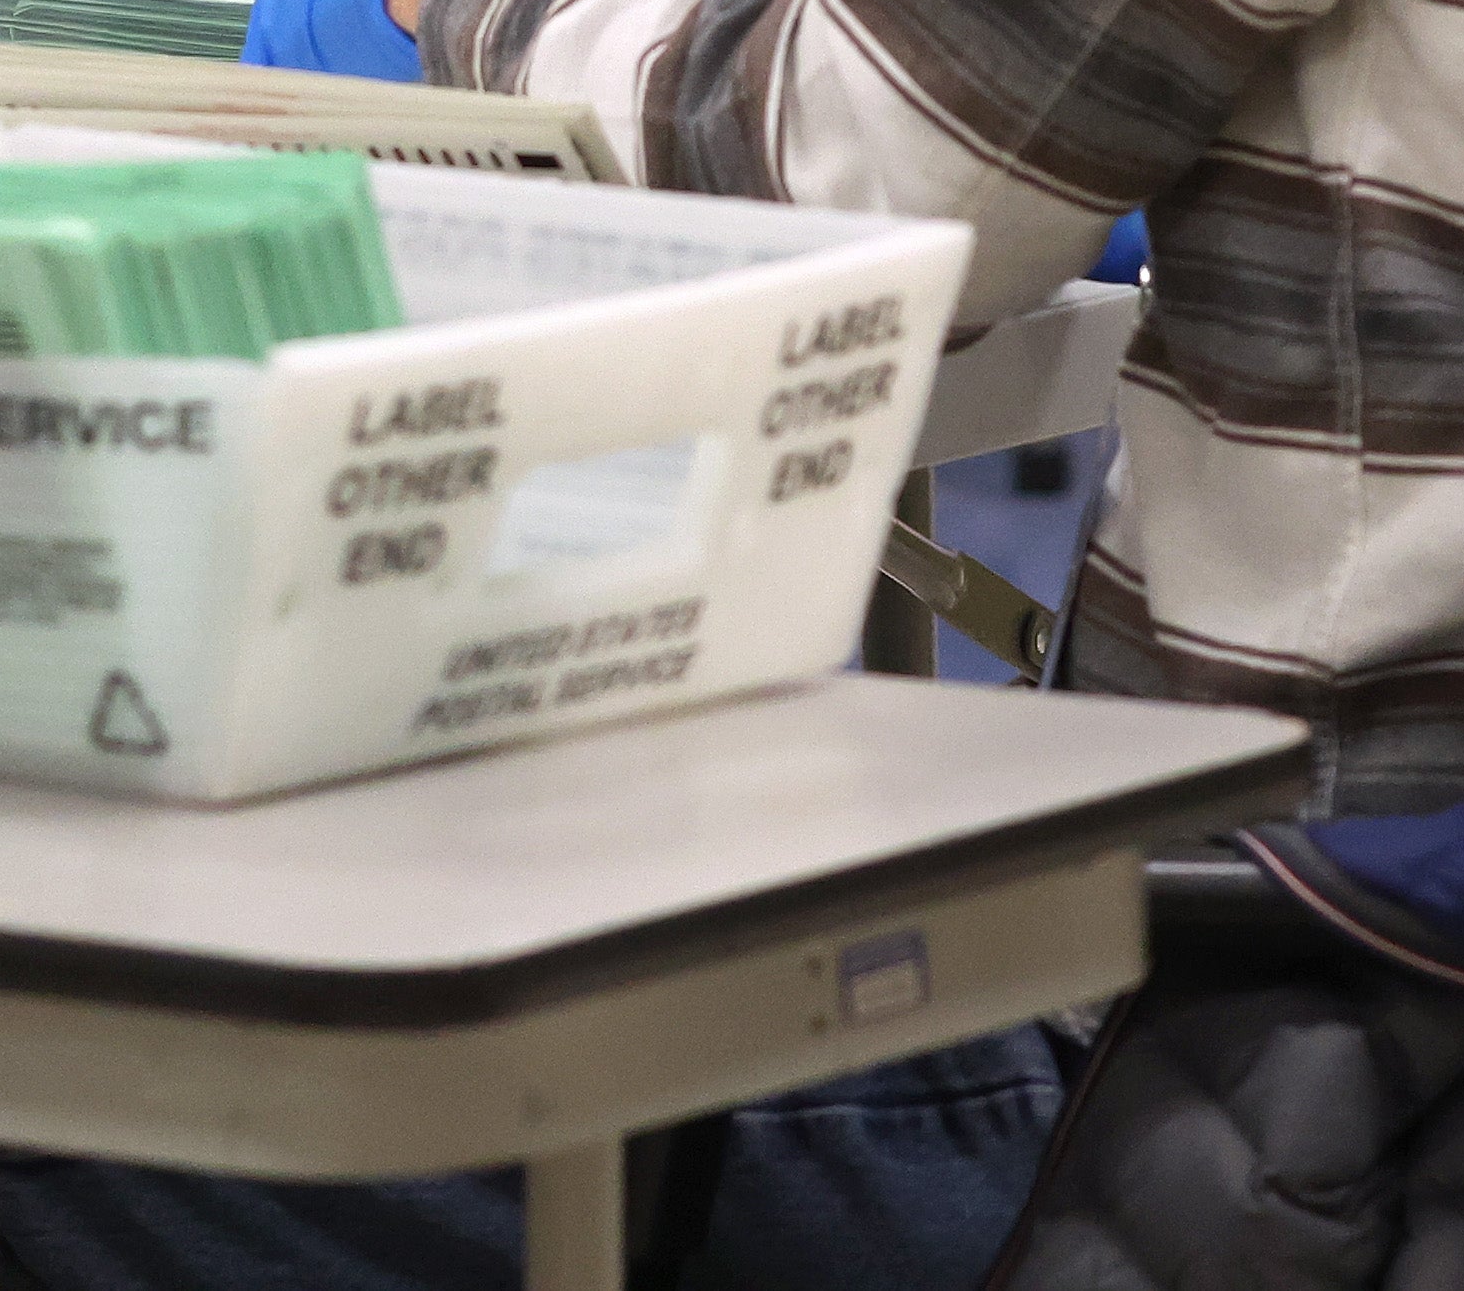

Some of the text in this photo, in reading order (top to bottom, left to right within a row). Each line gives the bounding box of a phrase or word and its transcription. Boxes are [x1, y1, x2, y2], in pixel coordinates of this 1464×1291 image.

[780, 294, 908, 370] LABEL
[346, 378, 507, 450] LABEL
[759, 359, 900, 440] OTHER
[326, 446, 501, 518] OTHER
[768, 437, 856, 503] END
[340, 522, 450, 586] END
[441, 595, 707, 683] UNITED STATES
[411, 643, 699, 734] POSTAL SERVICE
